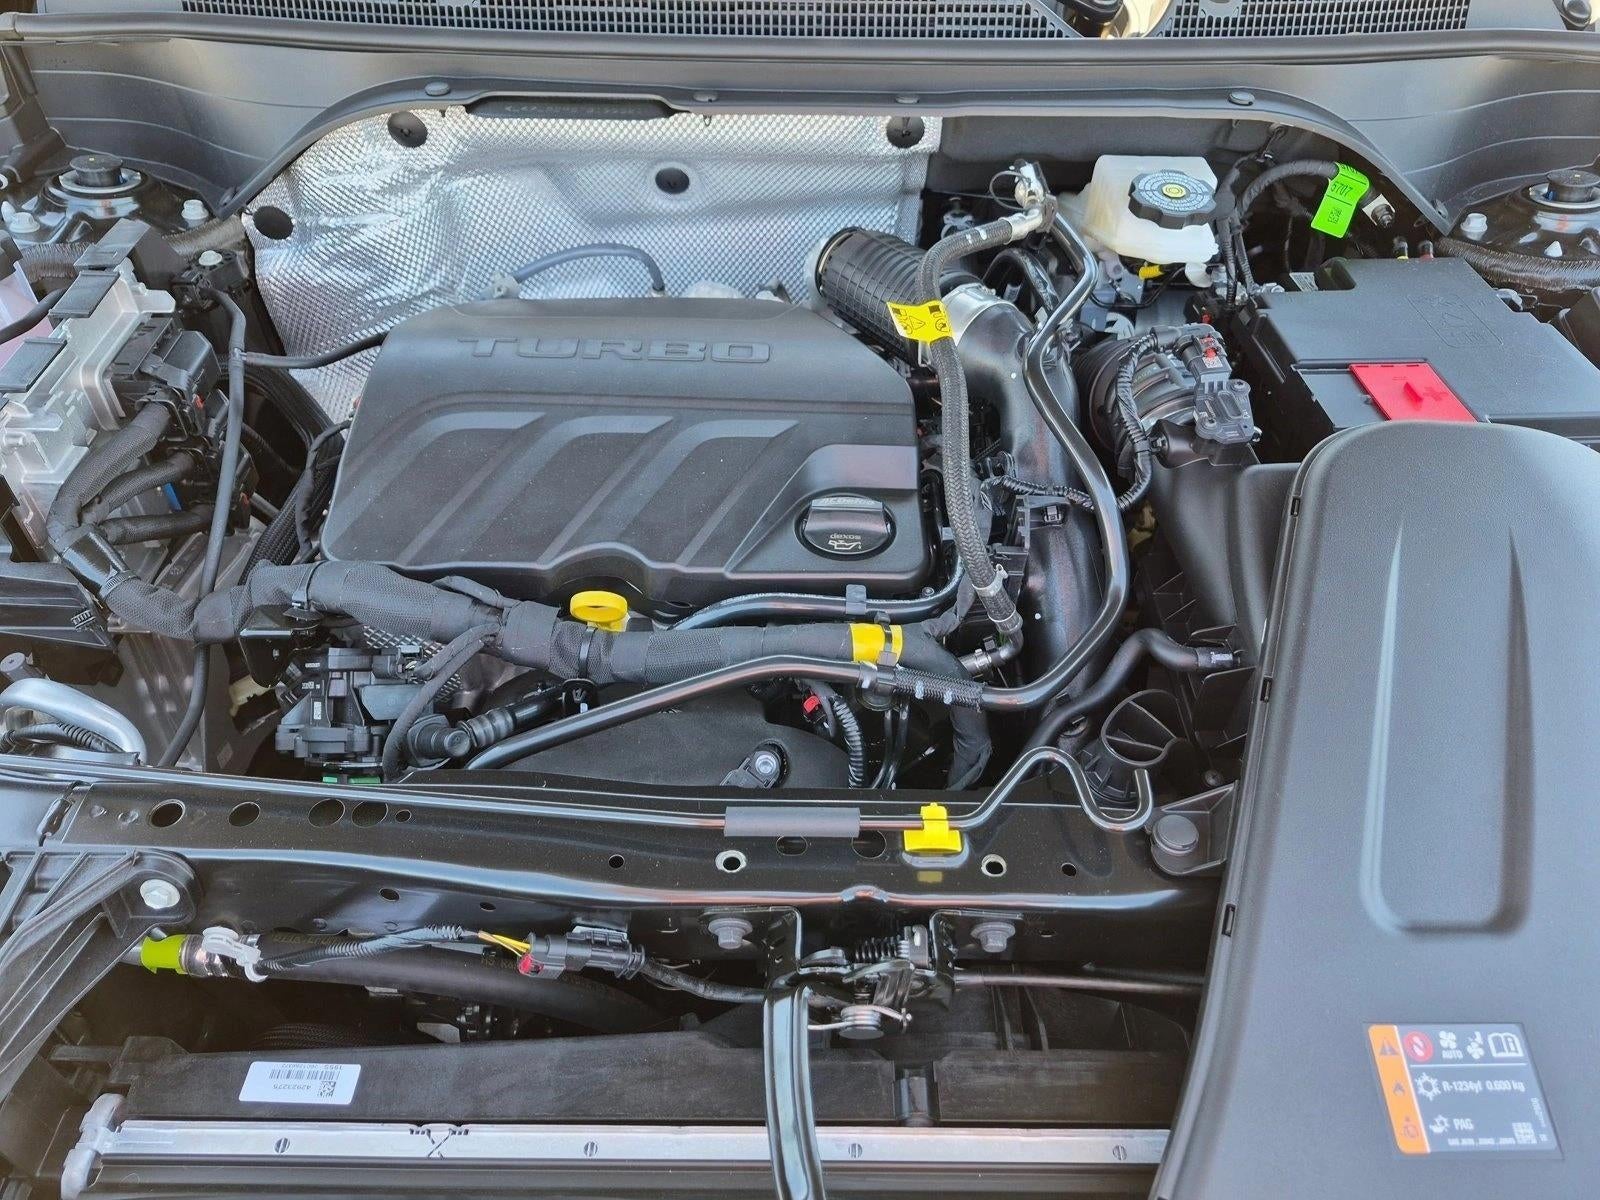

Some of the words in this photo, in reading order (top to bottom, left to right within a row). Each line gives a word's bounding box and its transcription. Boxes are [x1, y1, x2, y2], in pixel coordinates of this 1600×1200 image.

[1330, 180, 1354, 197] 5707
[458, 336, 771, 363] TURBO
[829, 532, 861, 540] dexos
[1442, 1049, 1464, 1059] AUTO
[1442, 1079, 1483, 1093] R-1234yf
[1511, 1079, 1526, 1093] kg
[1453, 1118, 1475, 1131] PAG
